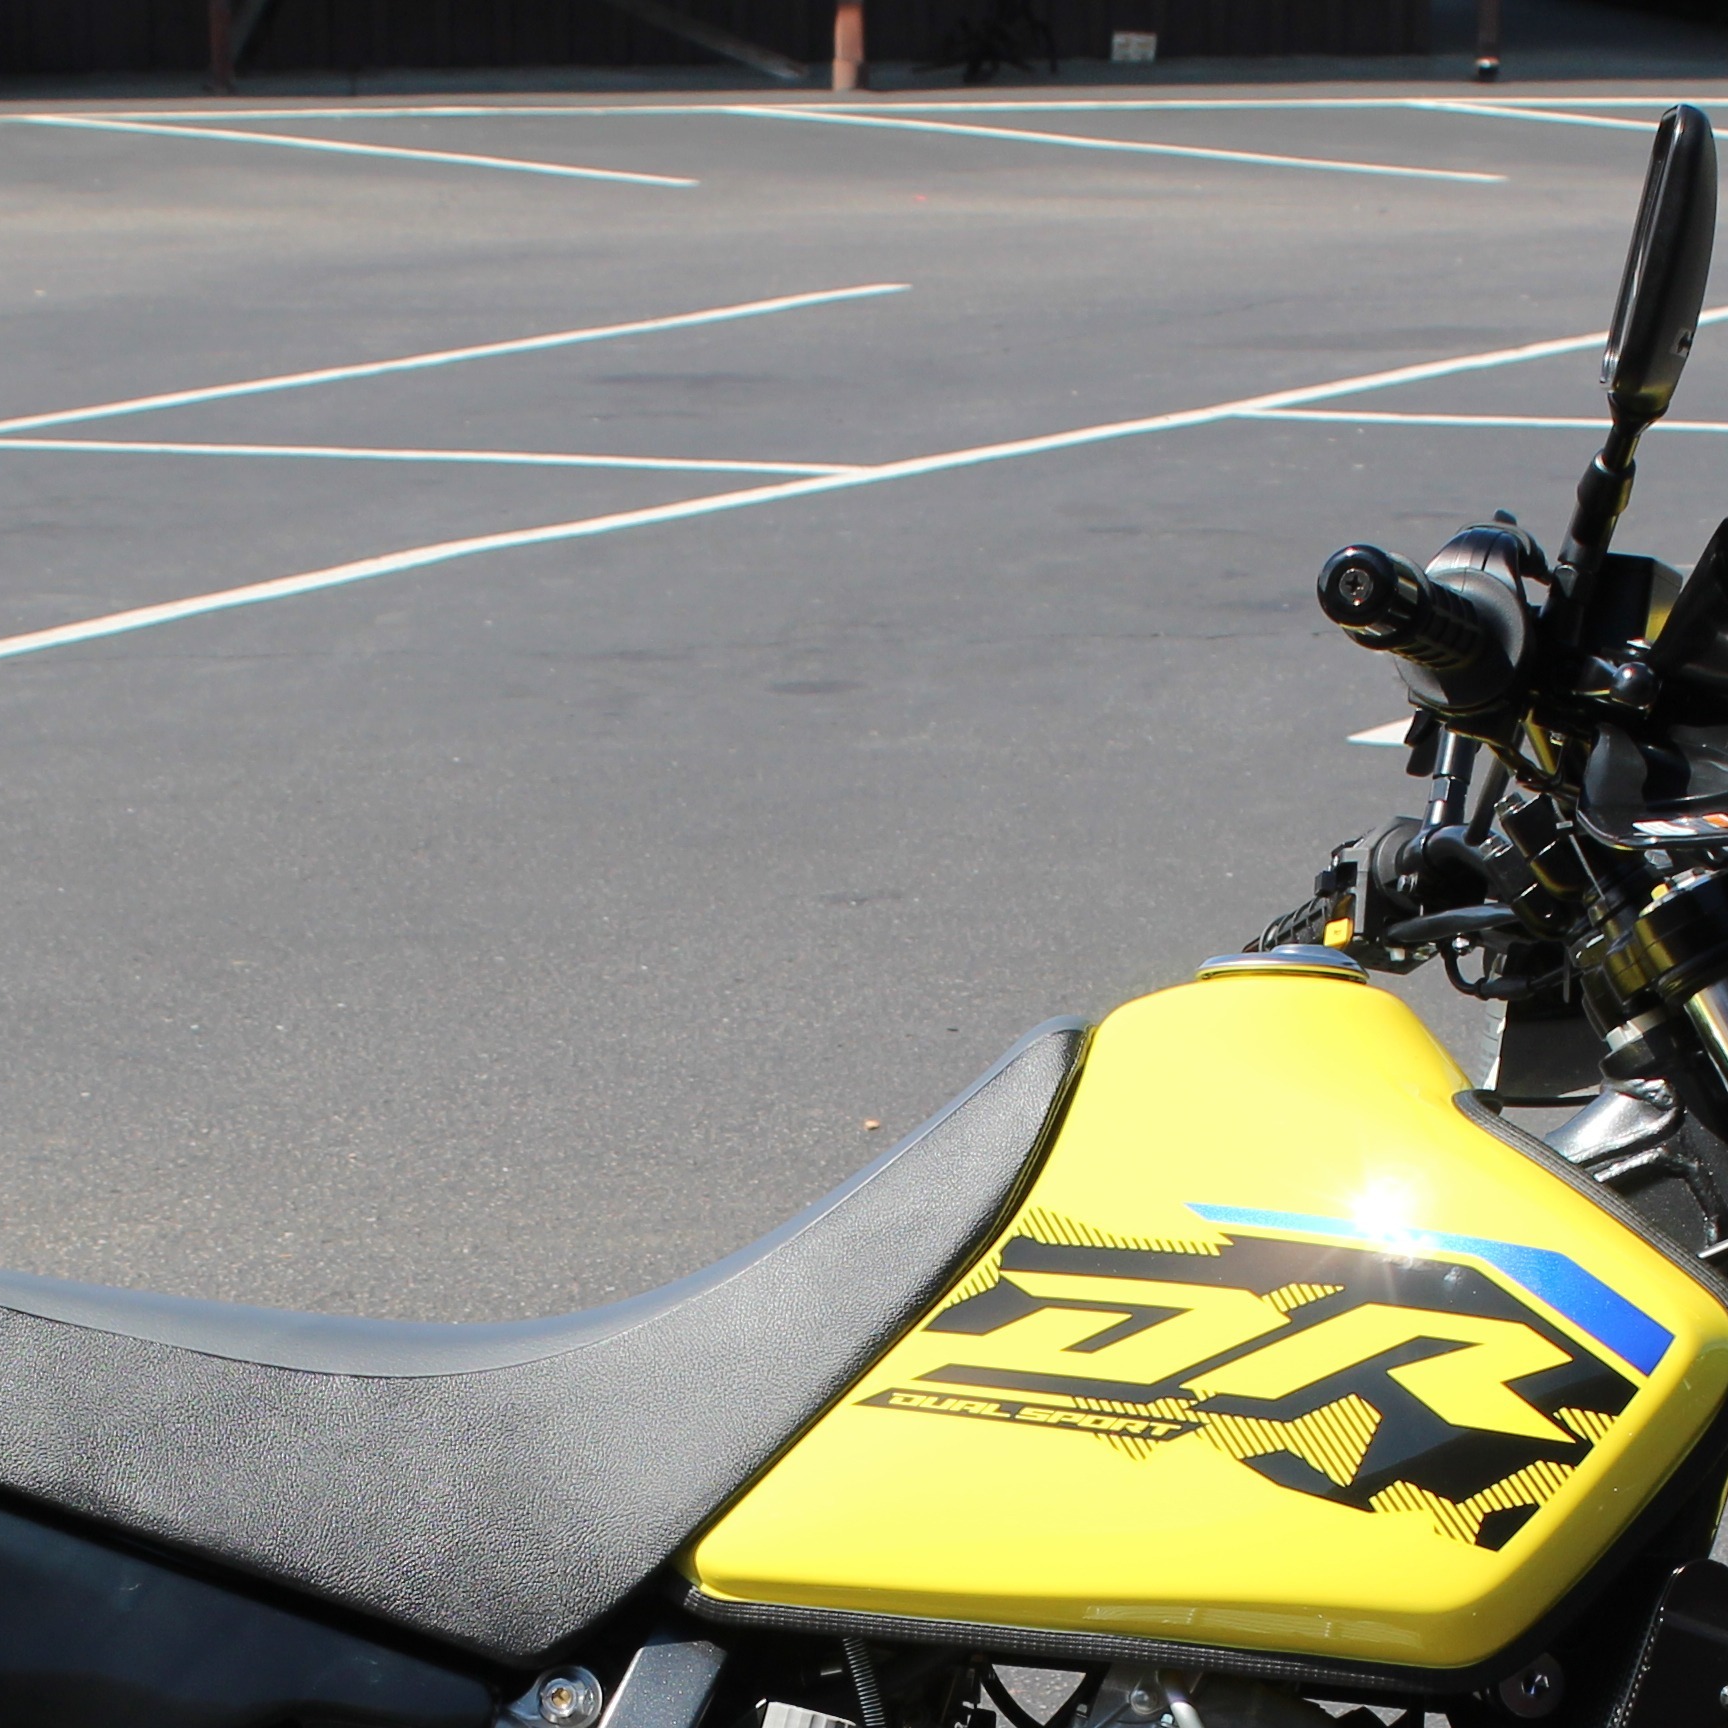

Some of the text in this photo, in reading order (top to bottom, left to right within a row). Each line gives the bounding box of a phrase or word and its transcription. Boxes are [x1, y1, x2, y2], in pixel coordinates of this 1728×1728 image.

[920, 1268, 1578, 1446] DR
[887, 1391, 1182, 1438] DUAL SPORT
